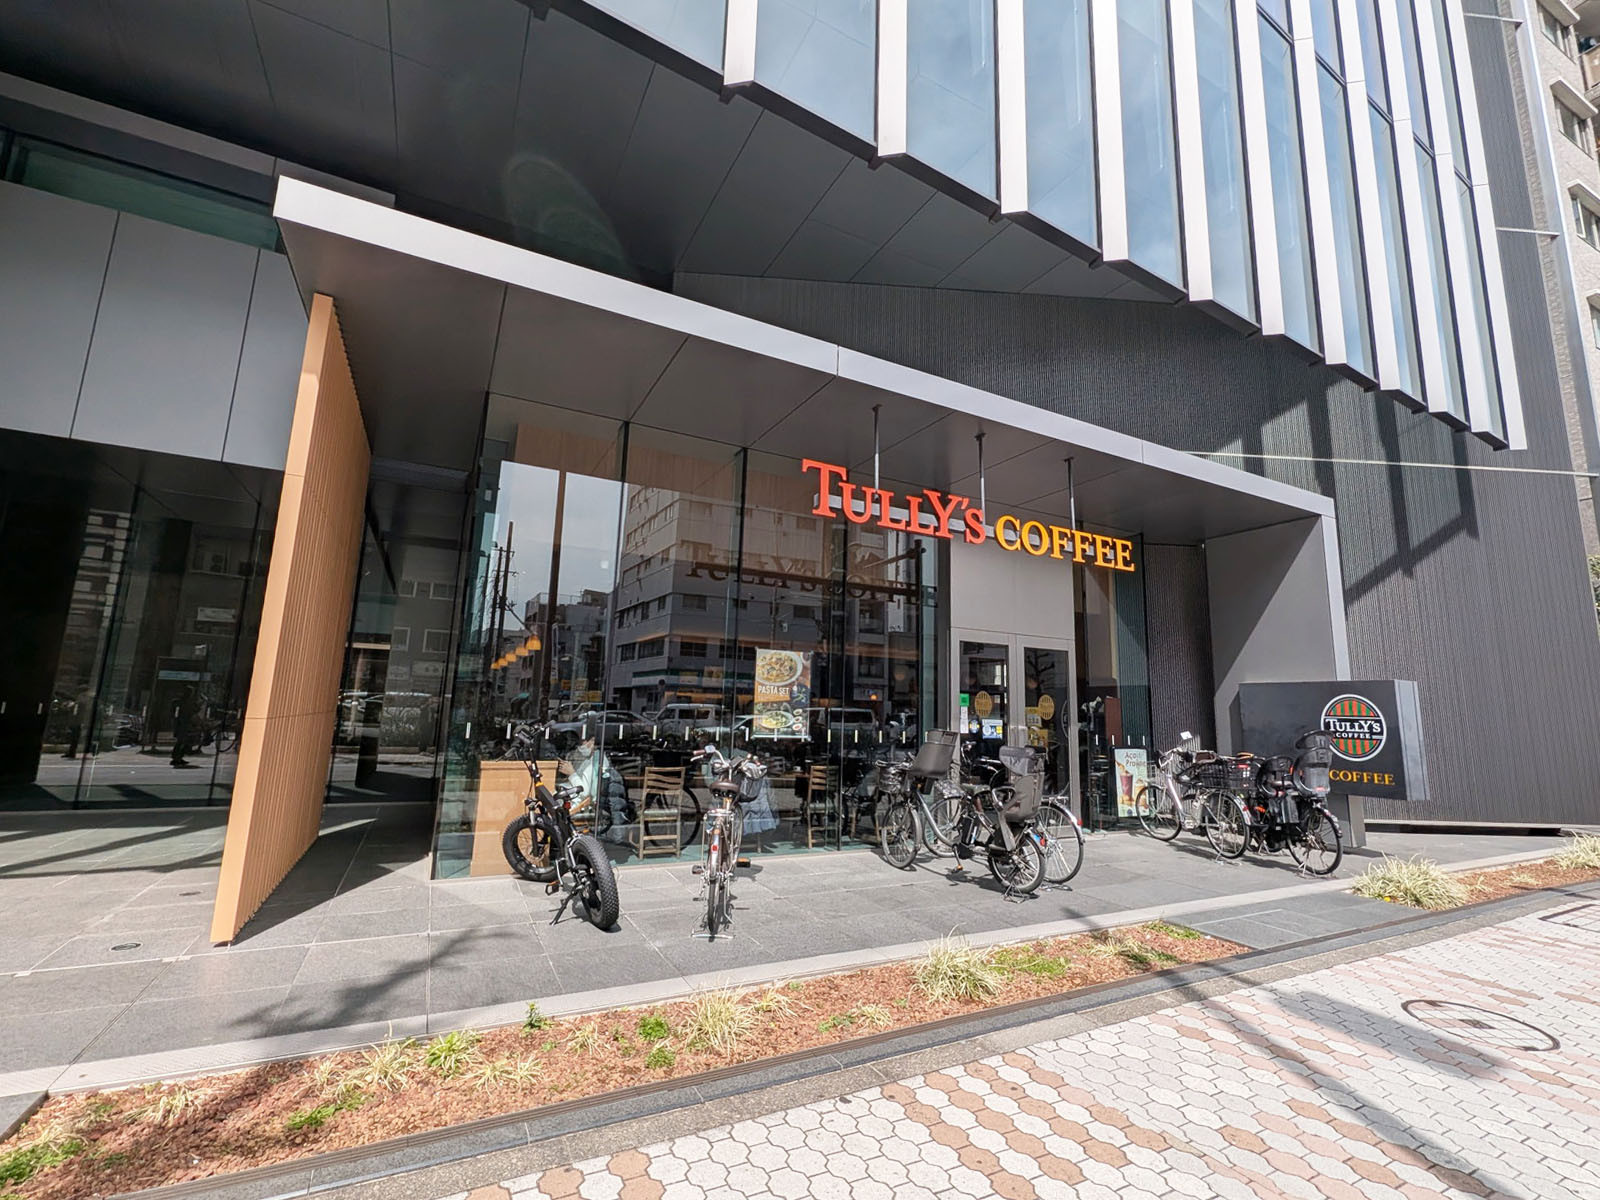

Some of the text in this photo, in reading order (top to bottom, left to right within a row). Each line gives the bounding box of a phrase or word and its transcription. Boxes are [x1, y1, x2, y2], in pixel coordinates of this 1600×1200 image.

[801, 458, 1136, 572] TULLY'S COFFEE
[758, 685, 790, 697] PASTA SET
[1325, 718, 1382, 733] TULLY'S
[1329, 769, 1396, 786] COFFEE
